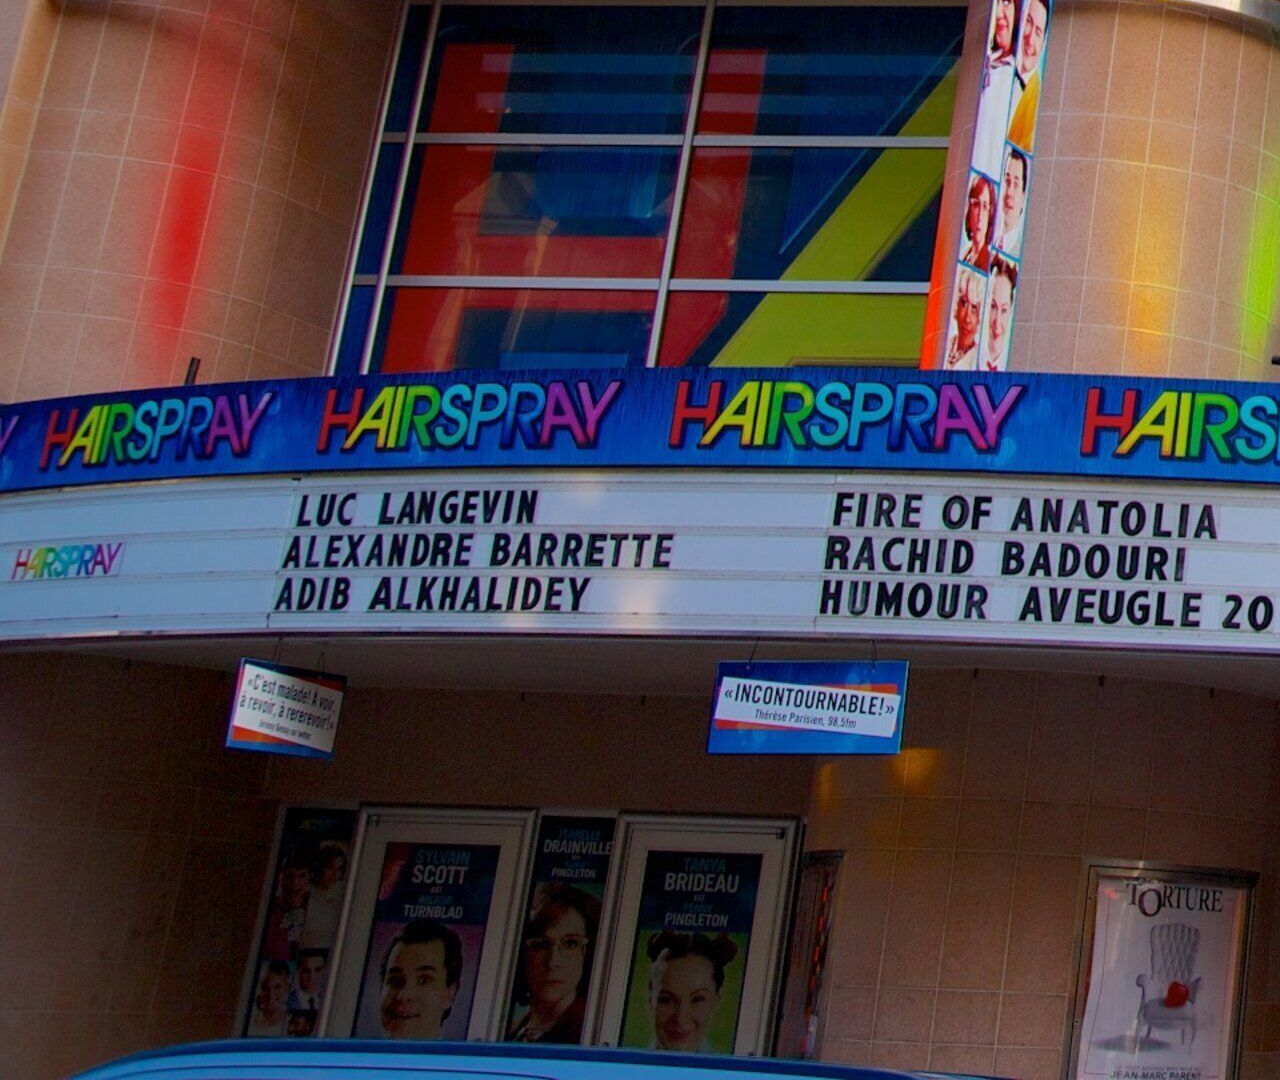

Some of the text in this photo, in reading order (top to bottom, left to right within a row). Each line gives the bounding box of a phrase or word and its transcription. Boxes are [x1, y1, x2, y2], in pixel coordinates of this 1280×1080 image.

[40, 392, 273, 469] HAIRSPRAY
[317, 379, 624, 455] HAIRSPRAY
[669, 379, 1023, 452] HAIRSPRAY
[295, 489, 539, 526] LUC LANGEVIN
[833, 492, 1218, 539] FIRE OF ANATOLIA
[11, 541, 123, 580] HAIRSPRAY
[281, 533, 675, 569] ALEXANDRE BARRETTE
[825, 536, 1186, 582] RACHID BADOURI
[274, 576, 592, 612] ADIB ALKHALIDEY
[820, 581, 1275, 632] HUMOUR AVEUGLE 20
[724, 683, 895, 716] «INCONTOURNABLE!»
[754, 708, 788, 722] Thérèse
[789, 712, 825, 727] Parisien,
[416, 850, 470, 864] SYLVAIN
[543, 839, 613, 855] DRAINVILLE
[411, 864, 468, 884] SCOTT
[664, 873, 740, 893] BRIDEAU
[404, 904, 463, 919] TURNBLAD
[1126, 882, 1223, 917] TORTURE
[665, 913, 729, 928] PINGLETON
